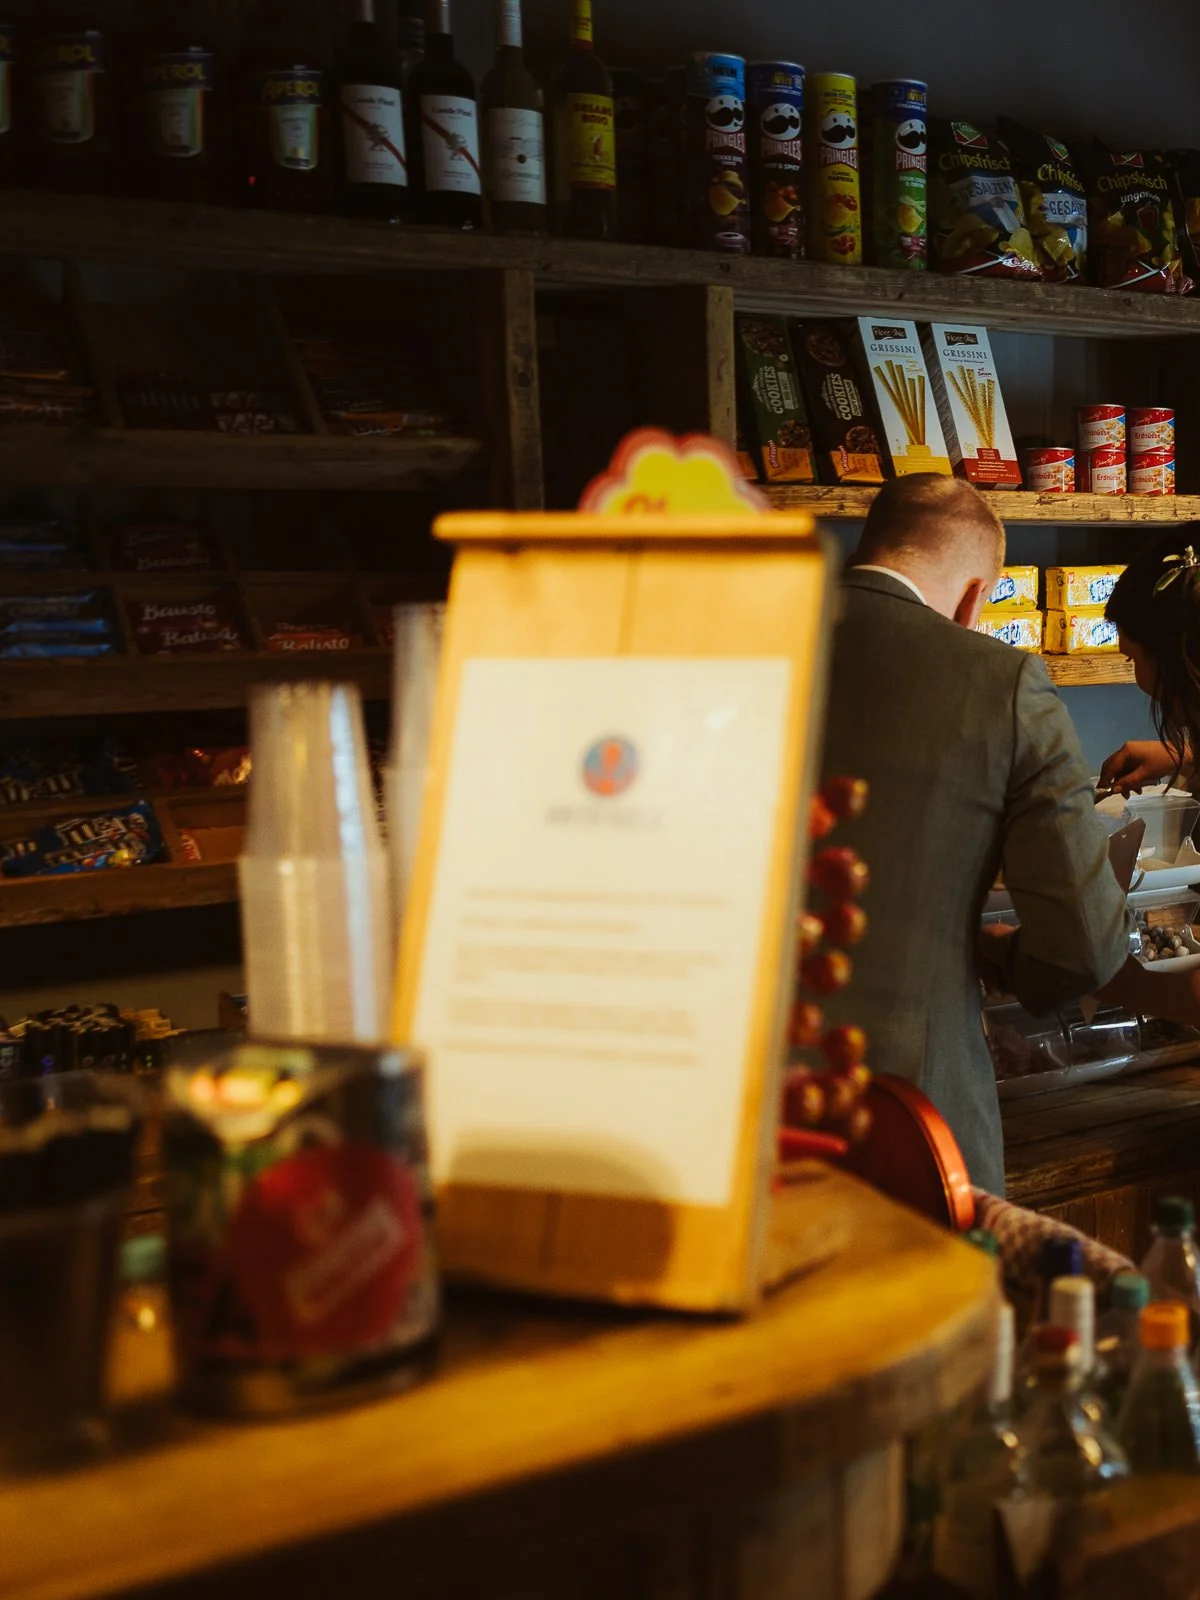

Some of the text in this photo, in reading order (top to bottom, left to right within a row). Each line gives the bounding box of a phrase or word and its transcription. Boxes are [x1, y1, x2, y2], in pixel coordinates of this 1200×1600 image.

[706, 129, 746, 153] PRINGLES
[761, 137, 801, 161] PRINGLES
[820, 146, 858, 170] PRINGLES
[870, 343, 917, 355] GRISSINI
[942, 349, 988, 360] GRISSINI
[764, 366, 784, 414] COOKIES
[830, 372, 852, 421] COOKIES
